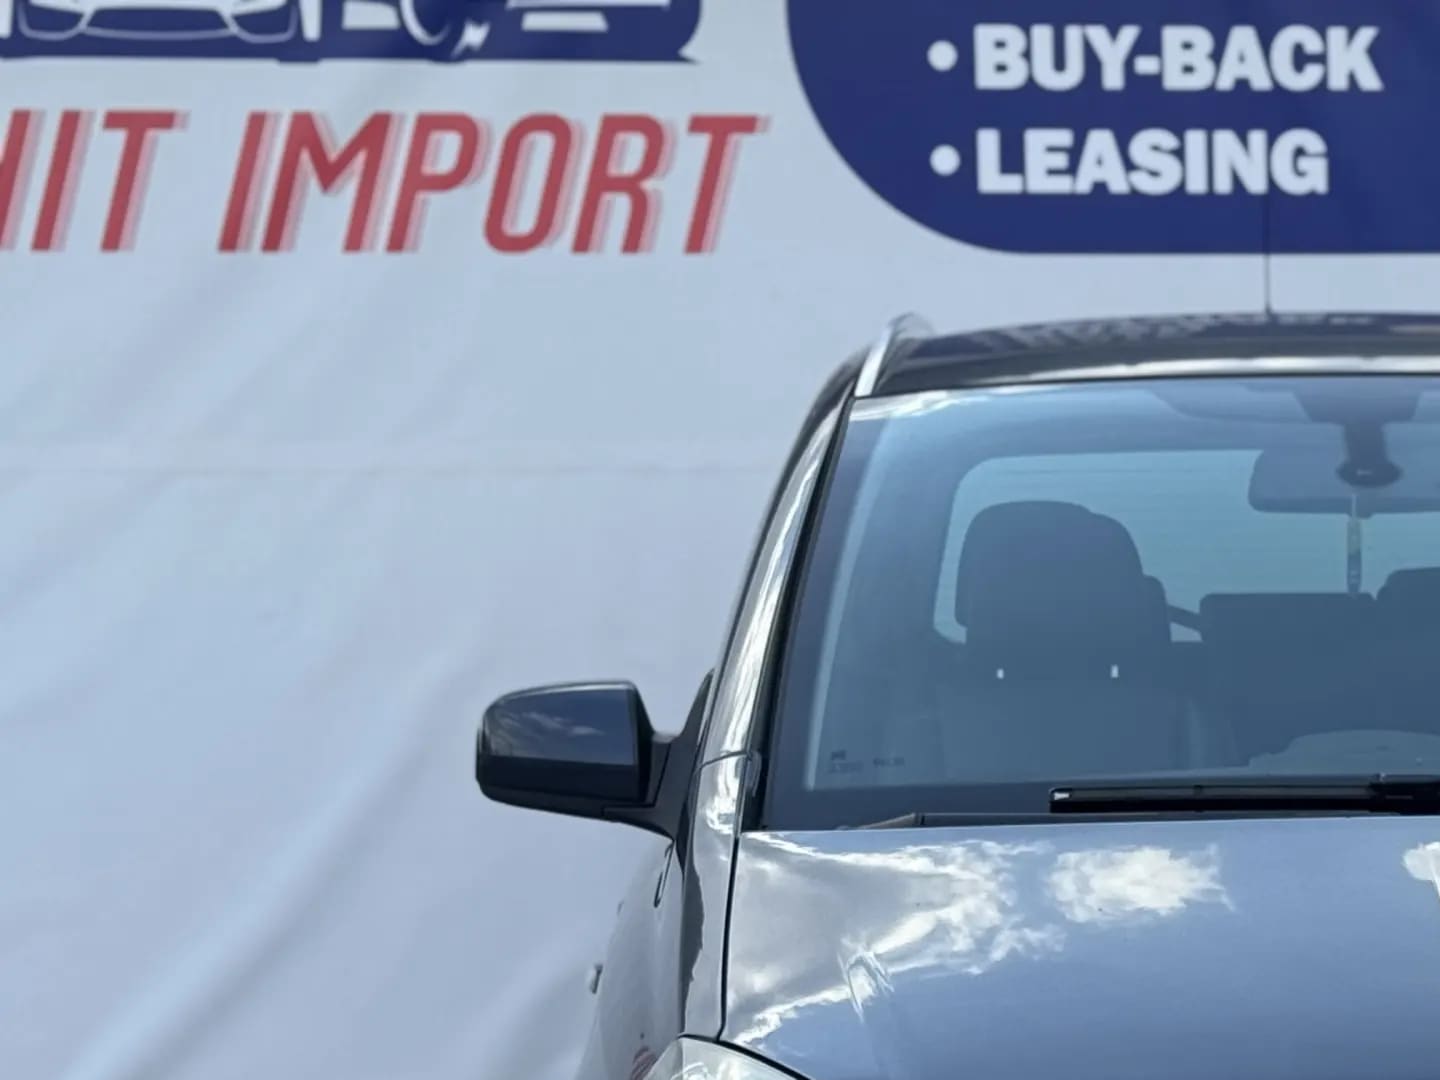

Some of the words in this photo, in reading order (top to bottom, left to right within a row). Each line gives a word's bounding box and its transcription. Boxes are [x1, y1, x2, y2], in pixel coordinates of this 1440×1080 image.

[973, 23, 1384, 91] BUY-BACK
[217, 110, 770, 254] IMPORT
[975, 128, 1329, 196] LEASING
